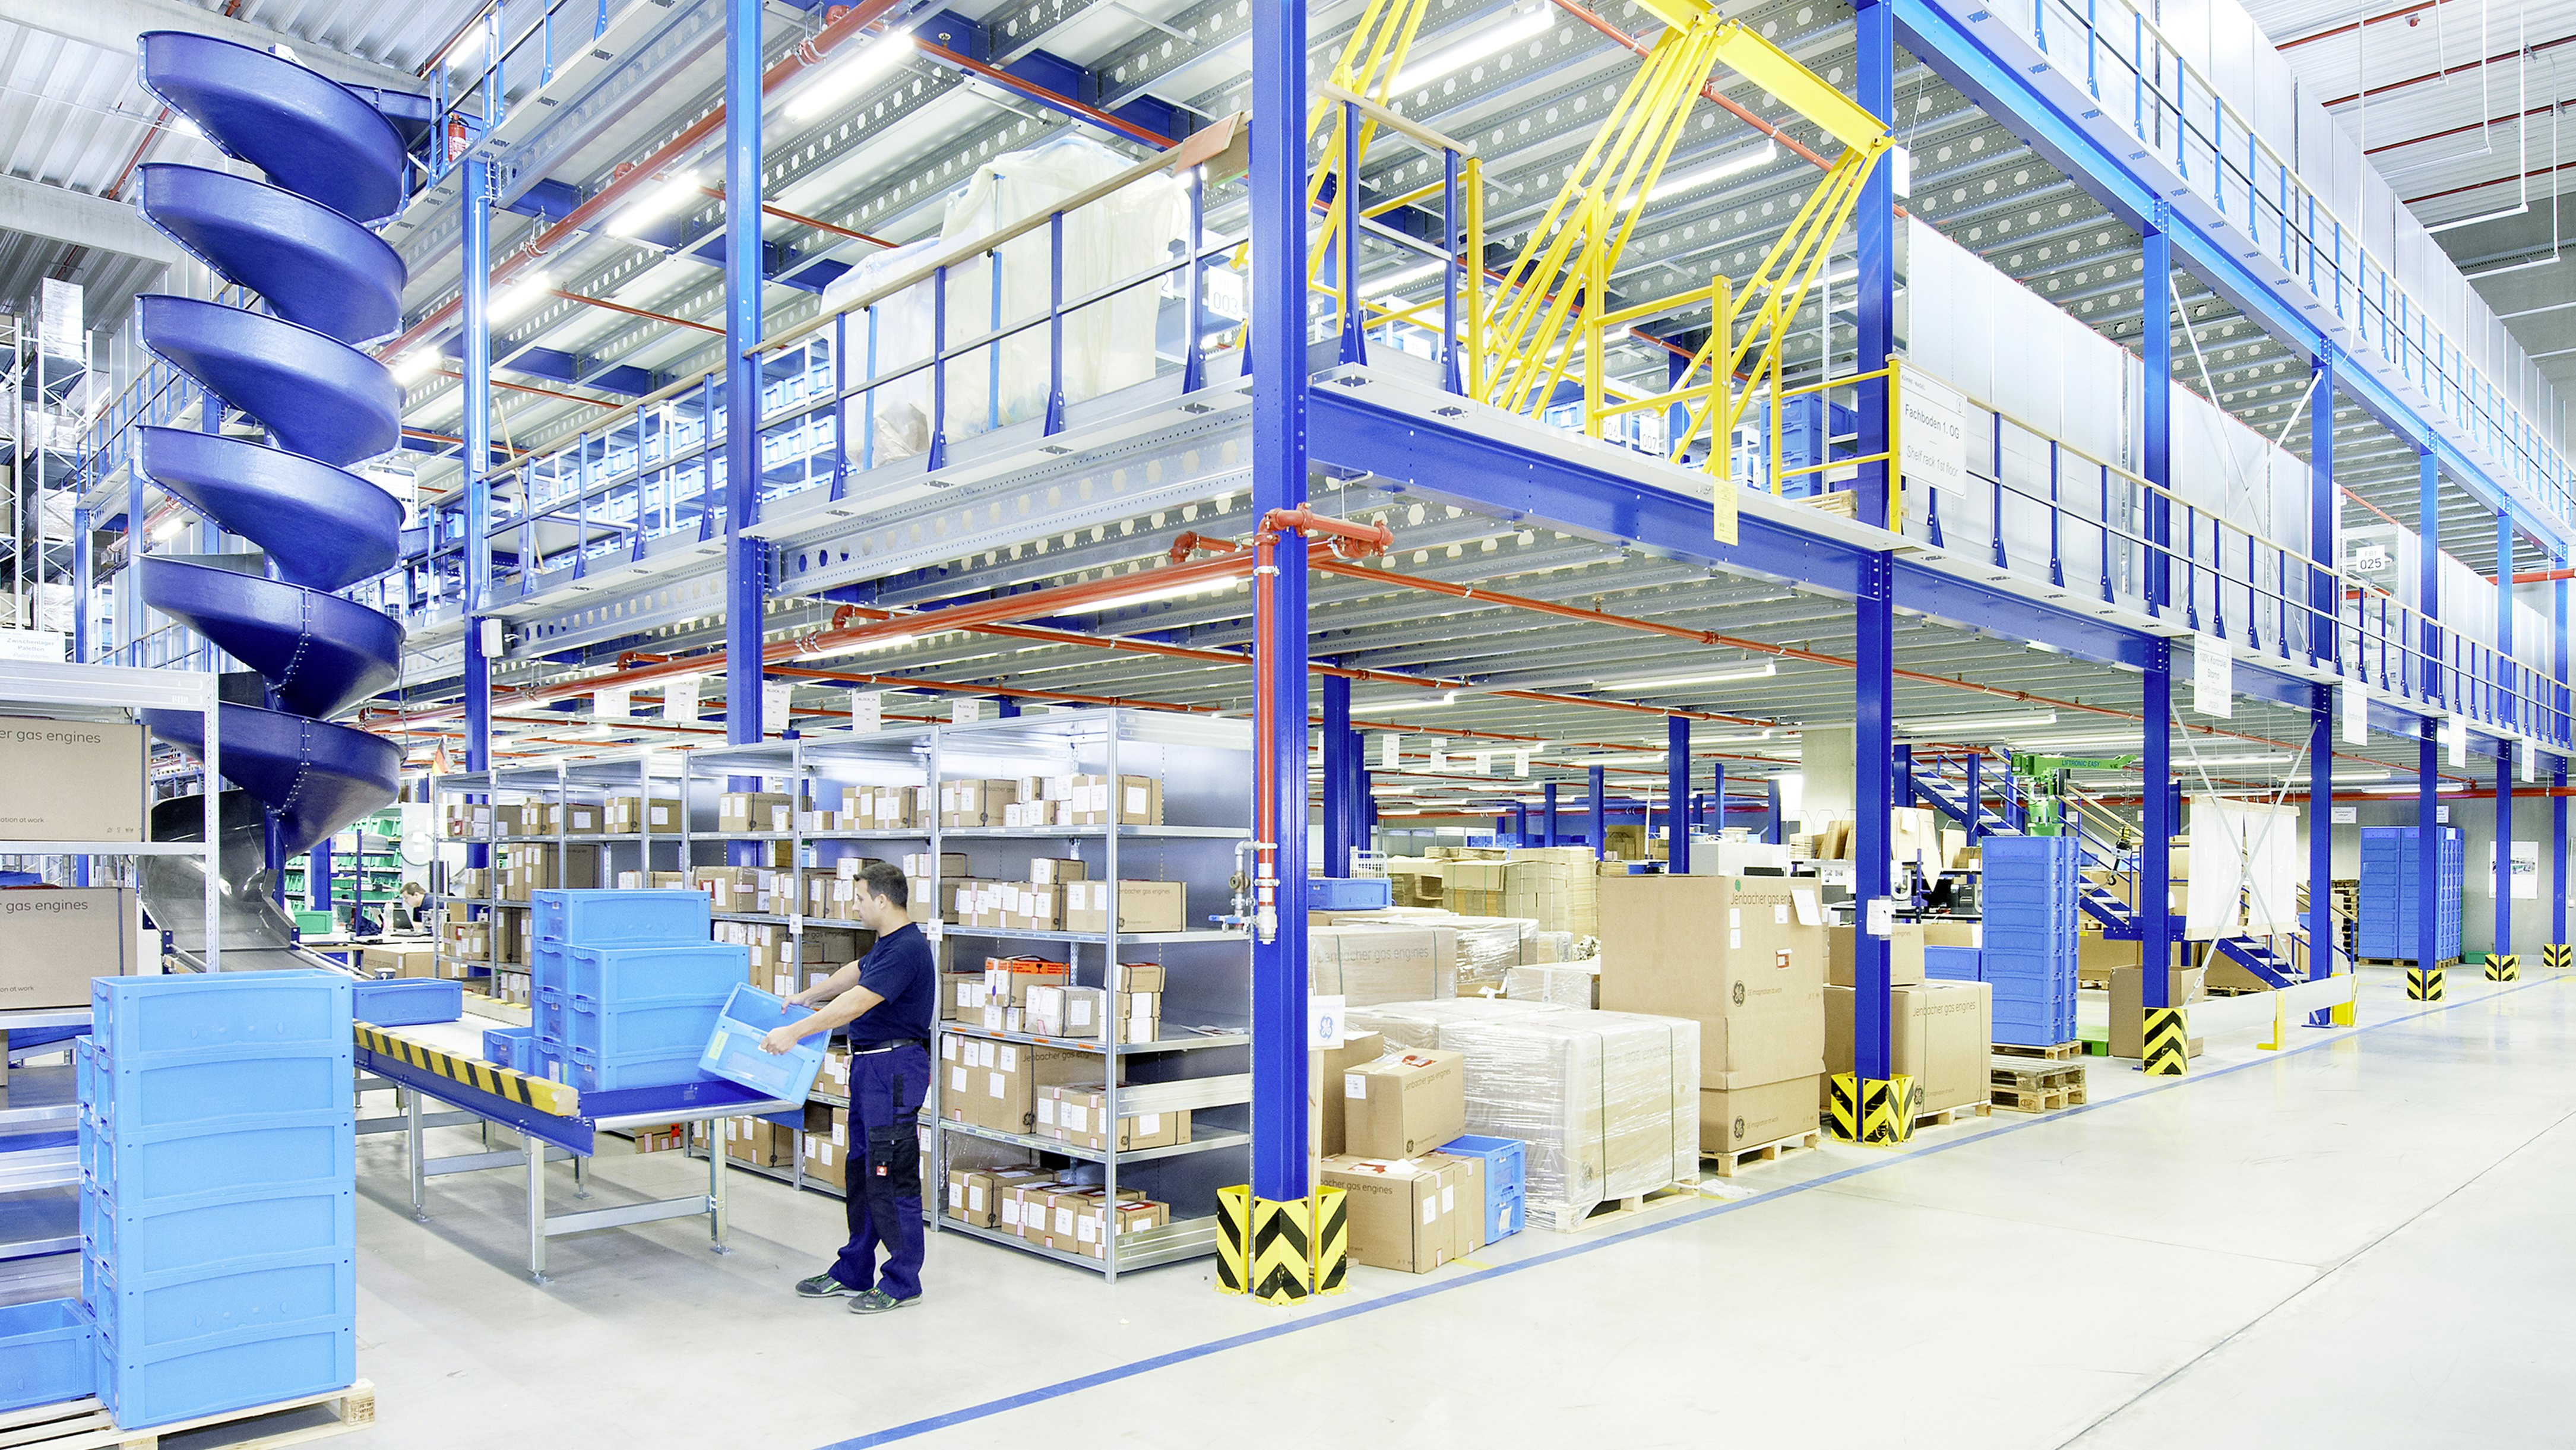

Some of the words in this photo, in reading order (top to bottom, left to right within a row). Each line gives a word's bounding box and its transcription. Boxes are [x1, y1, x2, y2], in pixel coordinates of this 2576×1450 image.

[1213, 292, 1238, 315] 003
[1905, 404, 1941, 431] Fachboden
[1943, 422, 1948, 435] 1.
[1950, 425, 1960, 439] OG
[1643, 433, 1657, 449] 007
[1906, 445, 1922, 463] Shelf
[1923, 454, 1935, 468] rack
[1936, 459, 1945, 473] 1st
[1945, 461, 1959, 477] floor
[2360, 558, 2382, 569] 025
[7, 638, 55, 647] Zwischenlager
[17, 730, 43, 743] gas
[47, 732, 102, 745] engines
[6, 901, 31, 914] gas
[35, 900, 88, 913] engines
[1730, 892, 1767, 906] Jenbacher
[1767, 894, 1780, 908] gas
[1374, 949, 1391, 963] gas
[1394, 947, 1429, 962] engines
[1913, 1003, 1944, 1017] Jenbacher
[1944, 1005, 1955, 1016] gas
[1955, 1000, 1976, 1014] engines
[1023, 1052, 1061, 1062] Jebacher
[1346, 1182, 1361, 1191] gas
[1362, 1183, 1393, 1195] engines
